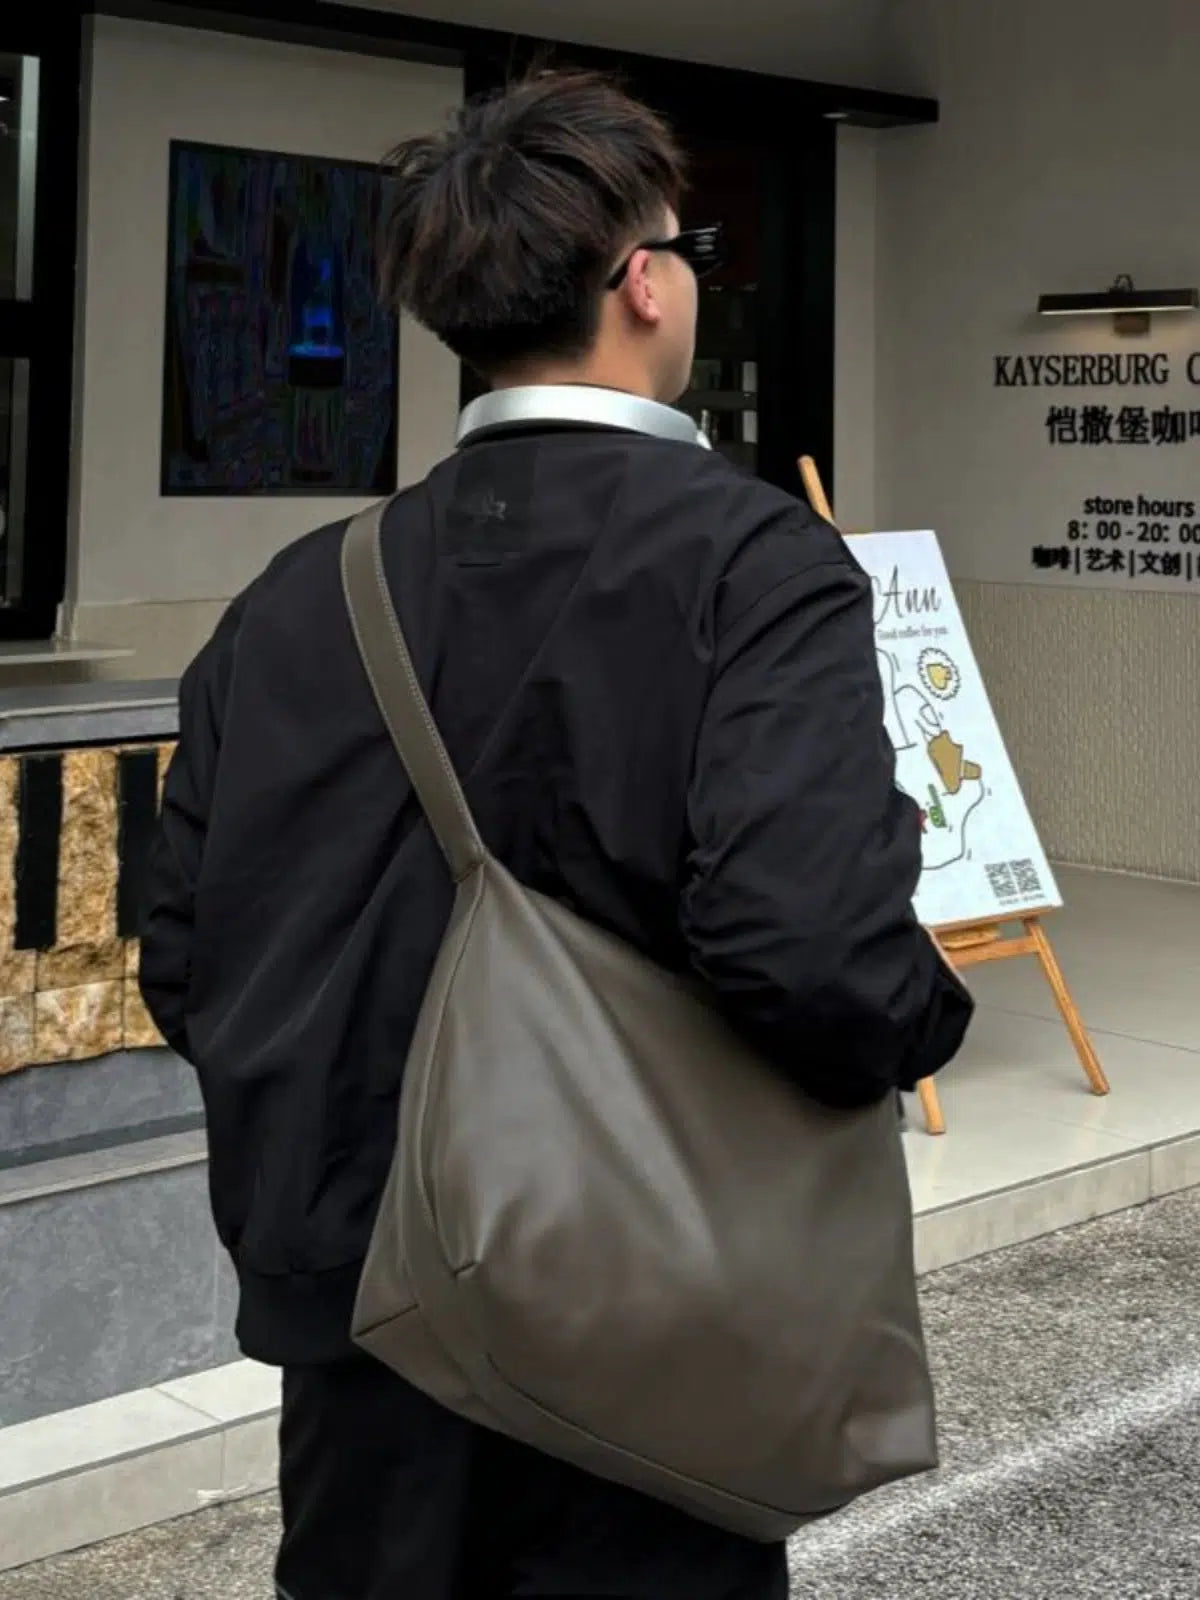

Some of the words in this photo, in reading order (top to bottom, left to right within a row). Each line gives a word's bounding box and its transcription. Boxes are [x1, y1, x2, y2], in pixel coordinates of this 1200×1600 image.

[993, 353, 1169, 386] KAYSERBURG
[1084, 497, 1133, 515] store
[1137, 494, 1195, 517] hours
